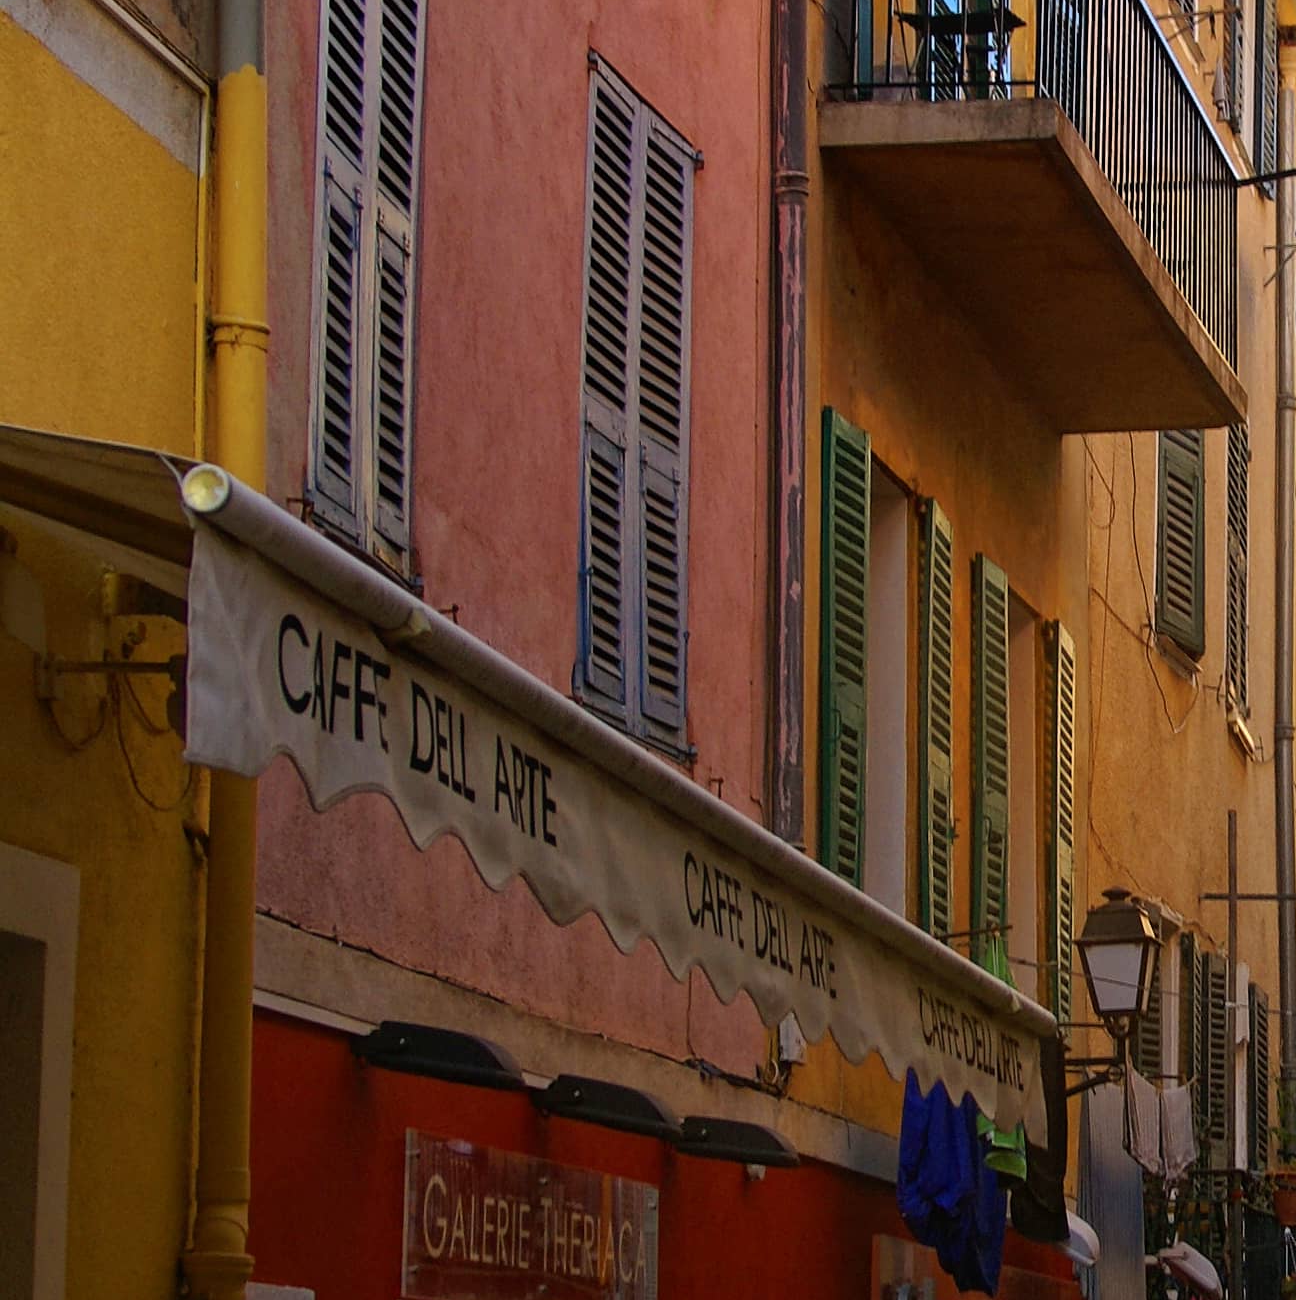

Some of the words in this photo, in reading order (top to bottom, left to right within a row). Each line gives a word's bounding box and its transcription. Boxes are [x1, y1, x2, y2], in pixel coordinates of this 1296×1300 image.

[277, 612, 392, 754] CAFFE
[409, 679, 476, 803] DELL
[494, 732, 558, 847] ARTE
[683, 850, 745, 950] CAFFE
[751, 889, 794, 974] DELL
[799, 919, 838, 999] ARTE
[961, 1012, 996, 1076] DELL
[423, 1172, 531, 1271] GALERIE
[540, 1196, 648, 1284] THERIACA
